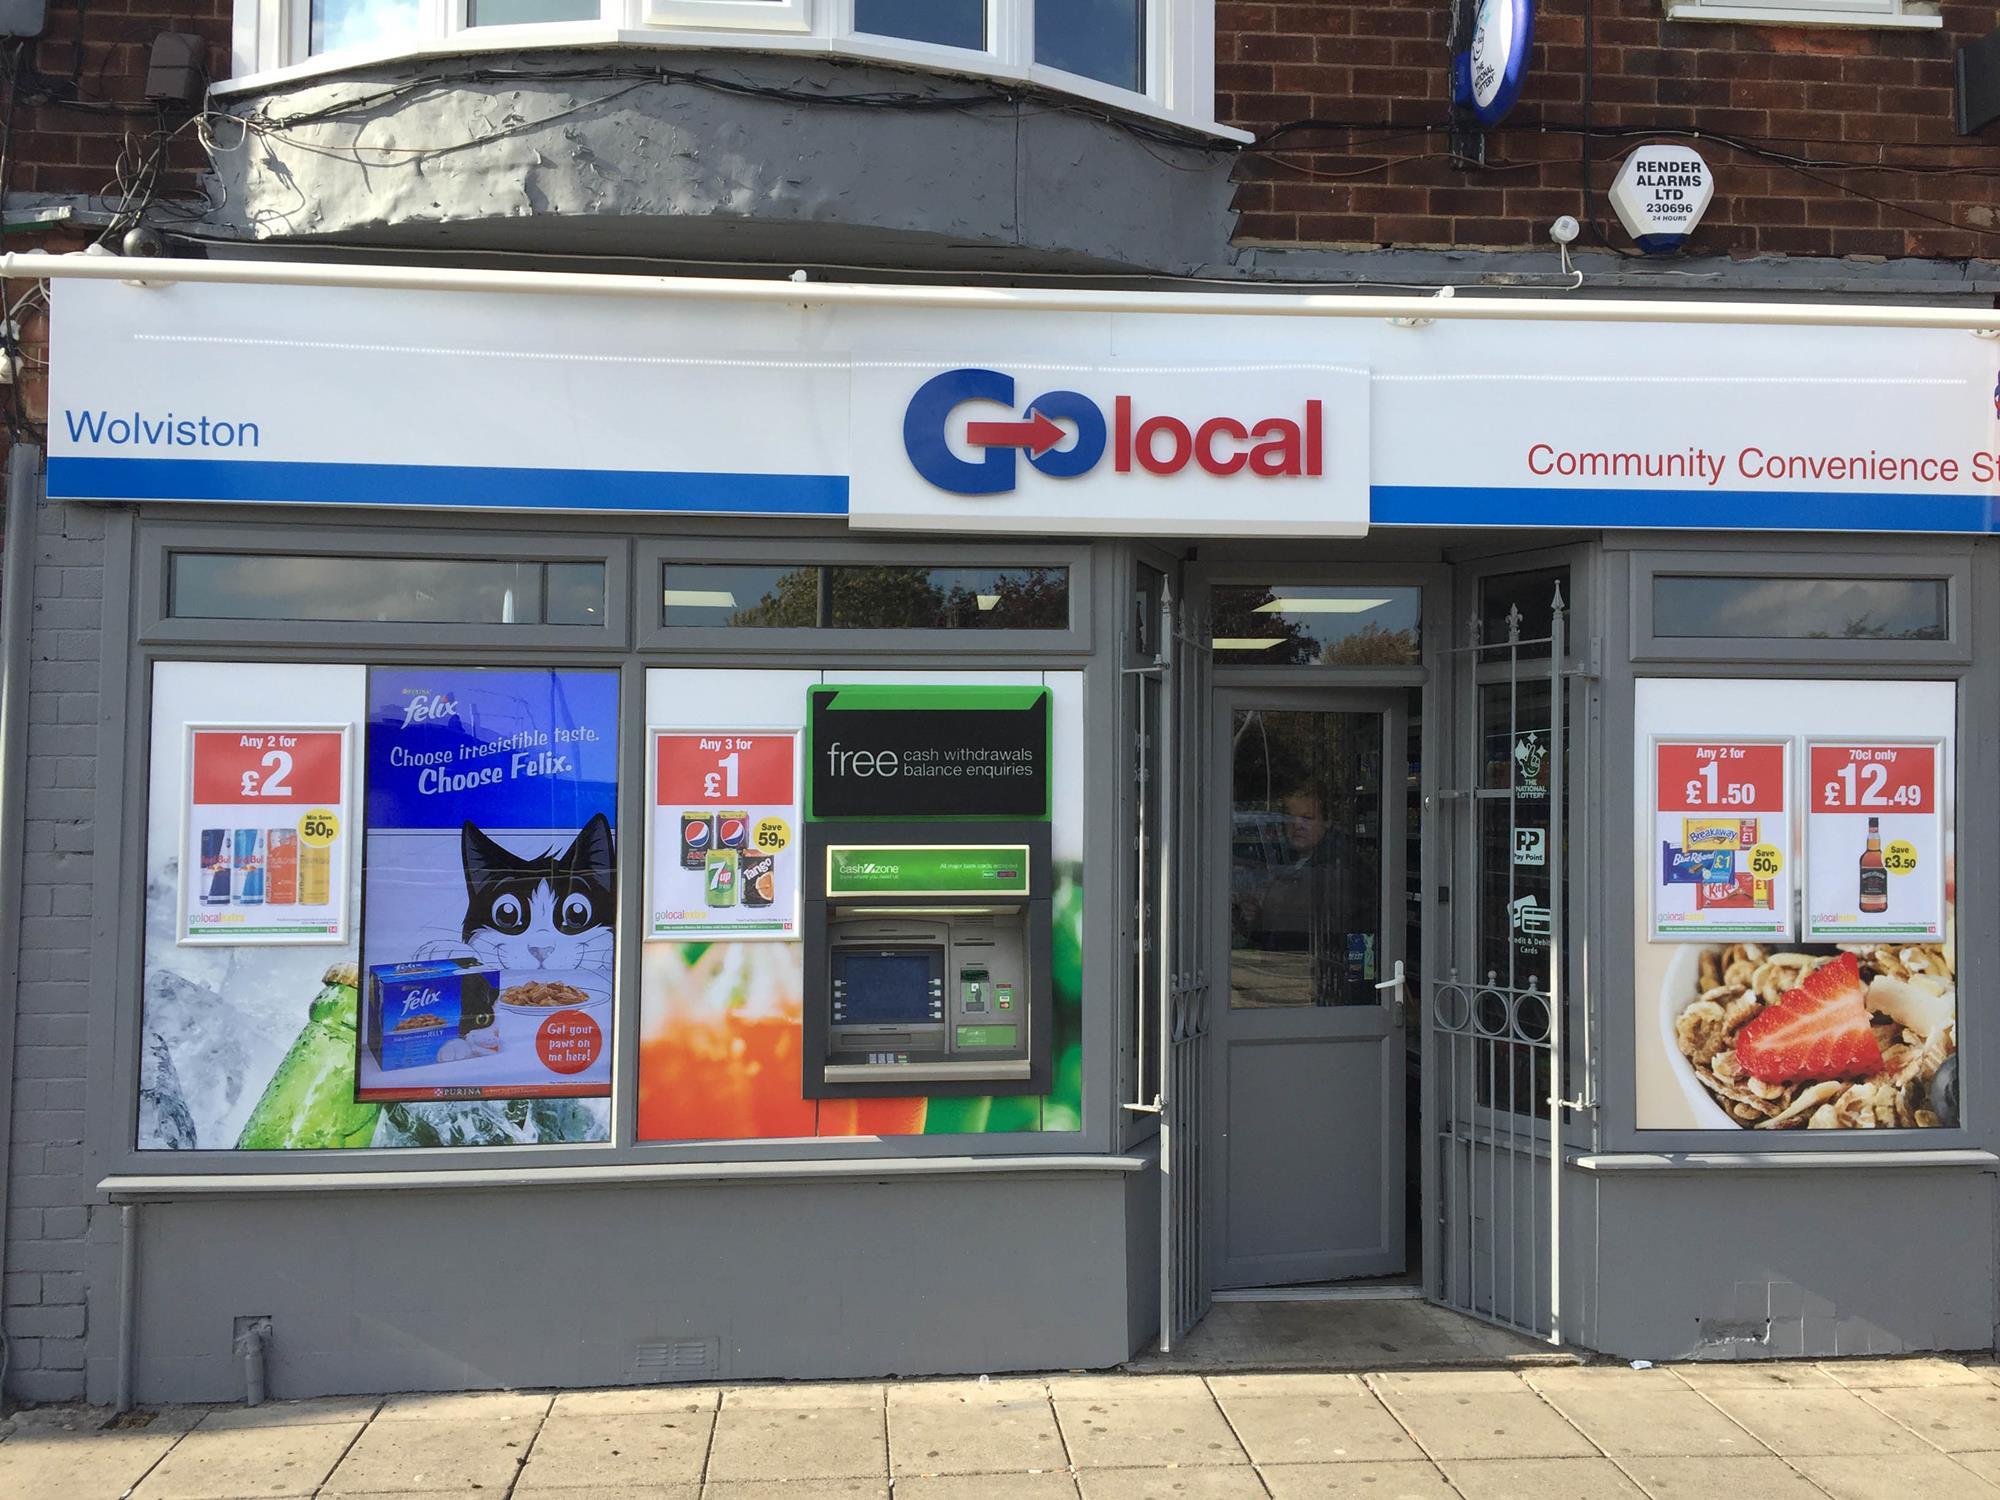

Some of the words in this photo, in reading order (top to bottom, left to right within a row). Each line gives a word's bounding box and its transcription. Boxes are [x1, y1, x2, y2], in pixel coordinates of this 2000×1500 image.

[1637, 161, 1701, 173] RENDER
[1636, 175, 1702, 187] ALARMS
[1655, 189, 1683, 200] LTD
[1646, 203, 1693, 213] 230696
[65, 410, 259, 447] Wolviston
[1528, 444, 1726, 486] Community
[1738, 447, 1959, 482] Convenience
[400, 695, 458, 729] felix
[240, 736, 263, 749] Any
[268, 736, 276, 747] 2
[279, 736, 297, 747] for
[390, 746, 453, 767] Choose
[459, 729, 548, 760] irresistible
[554, 726, 600, 743] taste.
[699, 738, 721, 752] Any
[725, 738, 733, 749] 3
[736, 738, 752, 749] for
[827, 742, 898, 777] free
[903, 748, 939, 761] cash
[944, 748, 1033, 761] withdrawals
[1696, 747, 1717, 760] Any
[1720, 748, 1727, 758] 2
[1729, 748, 1746, 758] for
[1849, 749, 1872, 760] 70cl
[1875, 749, 1897, 762] only
[241, 750, 293, 796] £2
[418, 764, 503, 795] Choose
[511, 751, 573, 779] Felix.
[704, 752, 739, 797] £1
[903, 763, 962, 777] balance
[966, 763, 1033, 779] enquiries
[1686, 761, 1756, 805] £1.50
[1824, 763, 1921, 806] £12.49
[304, 821, 334, 838] 50p
[761, 823, 782, 831] Save
[758, 833, 785, 848] 59p
[1756, 849, 1775, 857] Save
[1715, 855, 1731, 868] £1
[1753, 858, 1778, 873] 50p
[1885, 855, 1916, 868] £3.50
[744, 858, 772, 880] Tango
[1520, 946, 1538, 955] Cards
[402, 988, 441, 1016] felix
[547, 1023, 566, 1034] Get
[570, 1026, 592, 1036] your
[549, 1040, 575, 1050] paws
[566, 1049, 591, 1061] here!
[443, 1088, 481, 1096] PURINA
